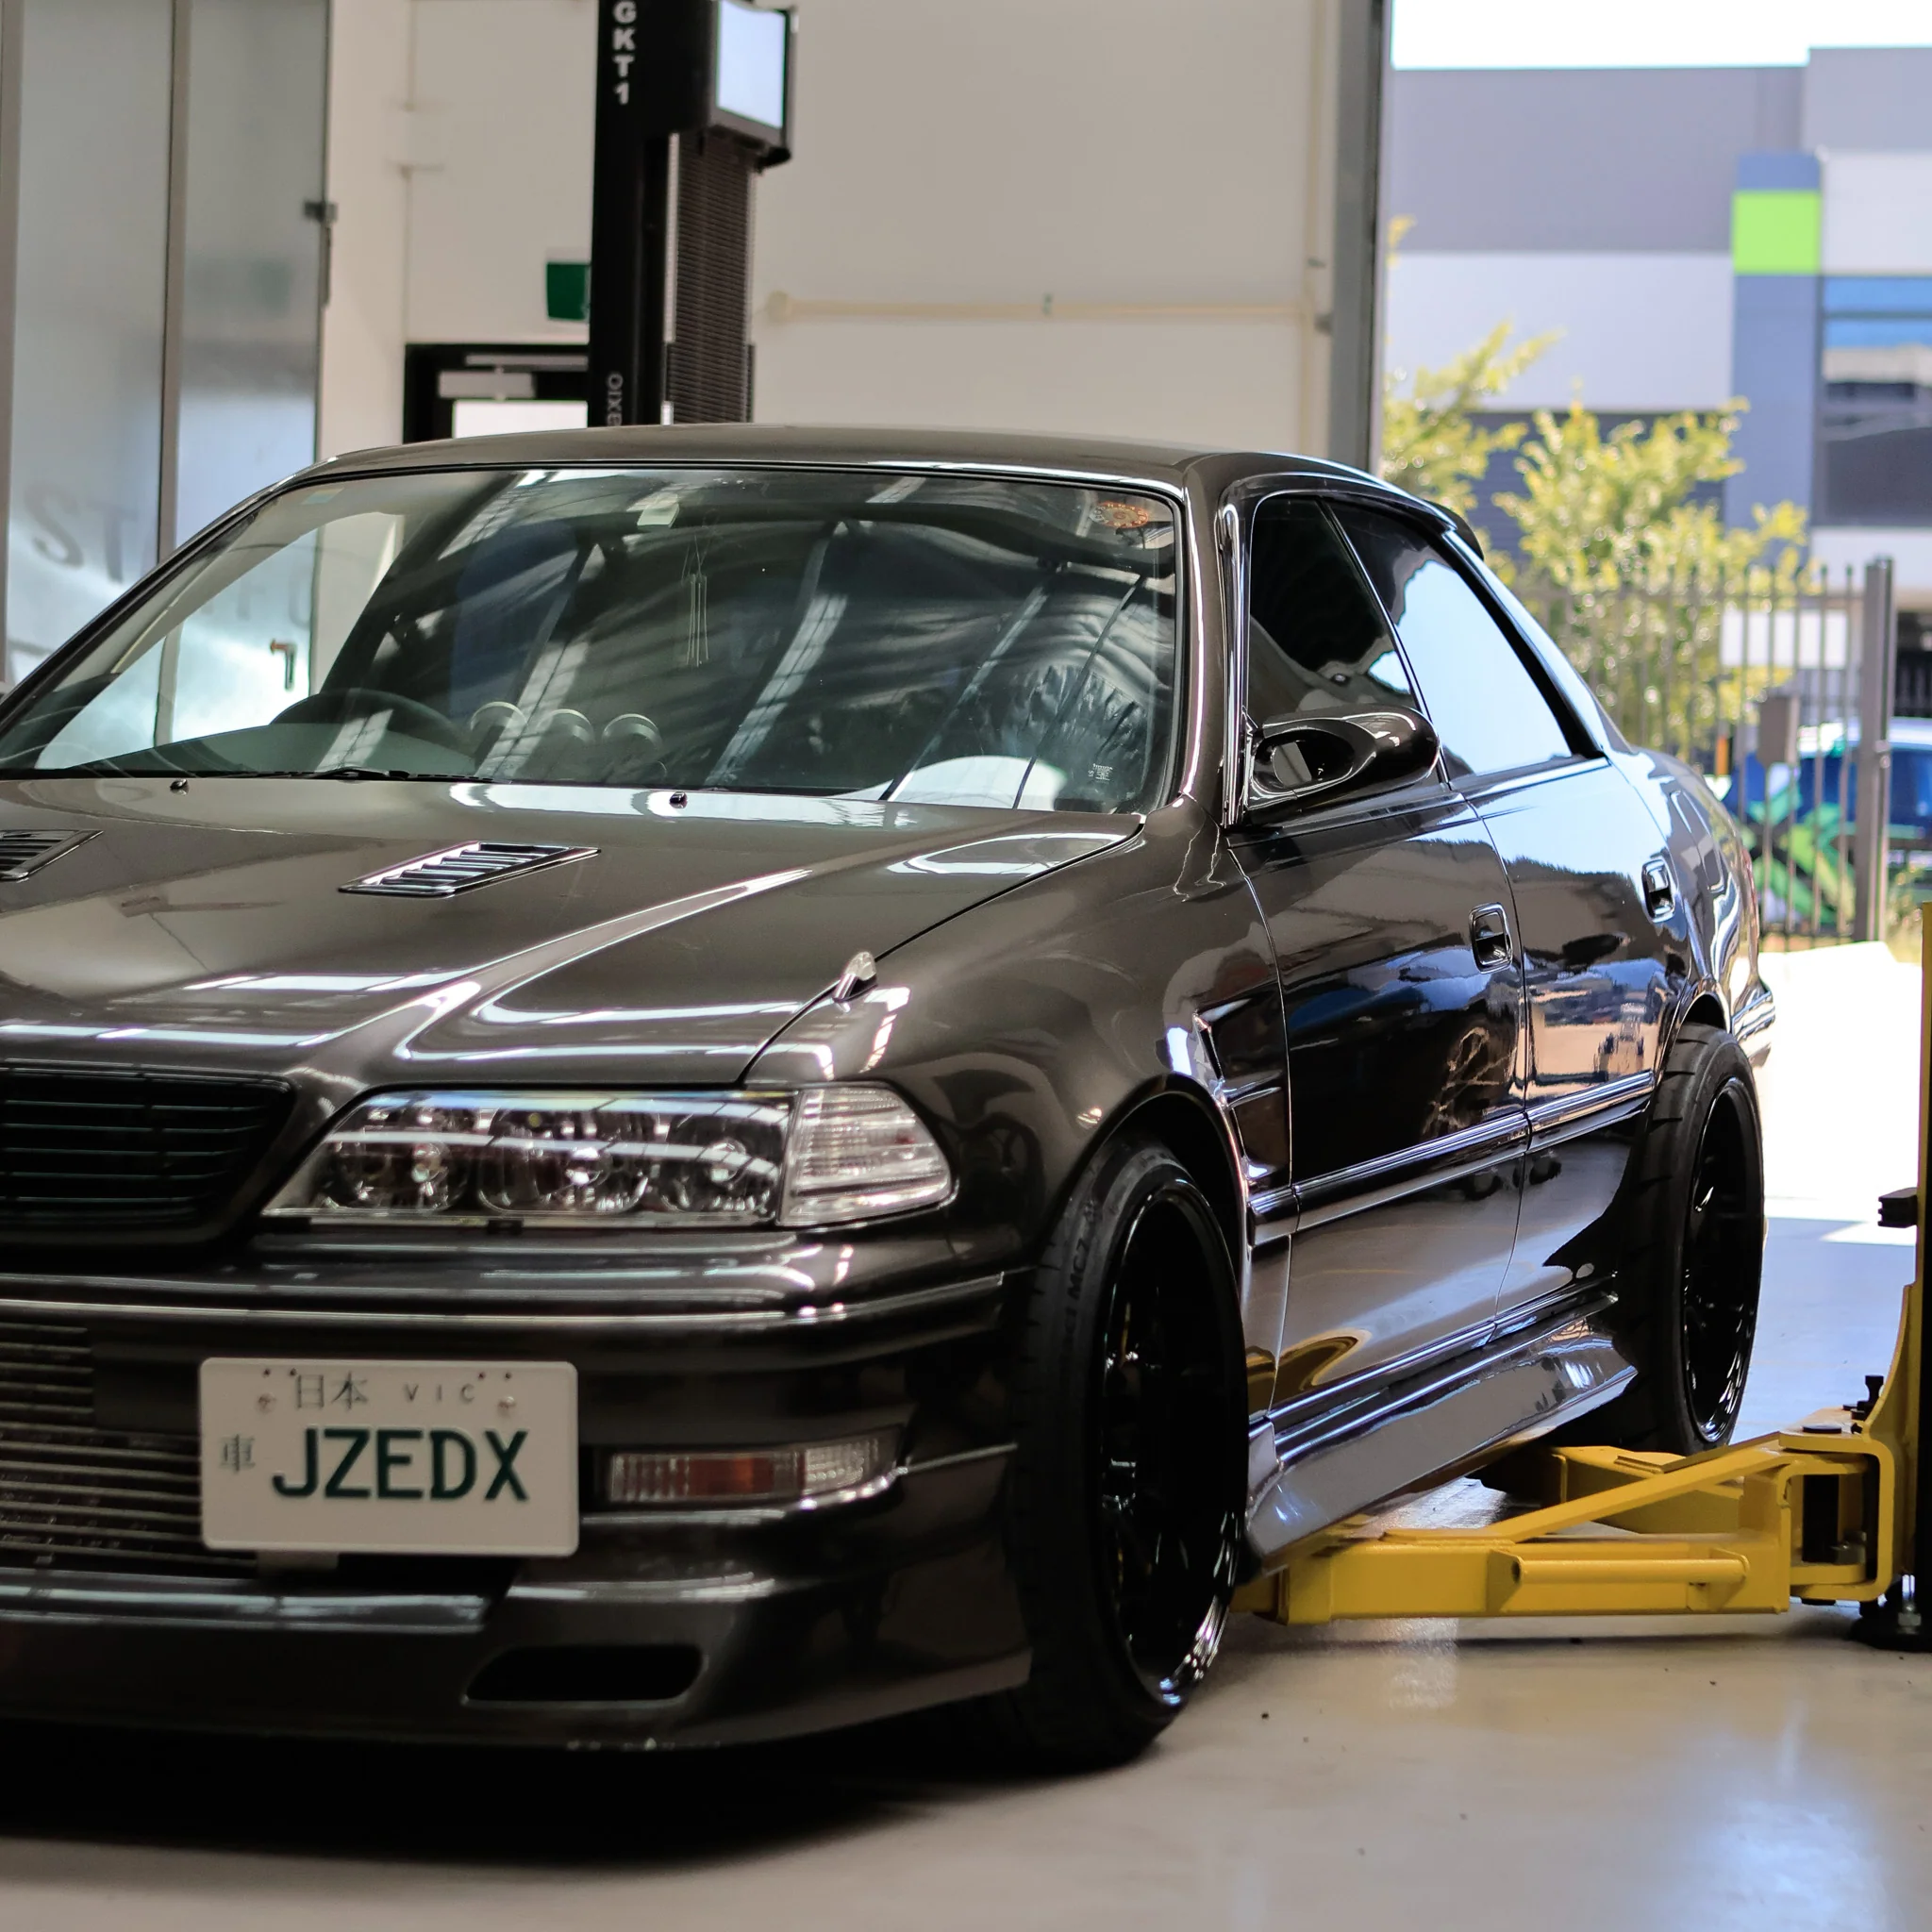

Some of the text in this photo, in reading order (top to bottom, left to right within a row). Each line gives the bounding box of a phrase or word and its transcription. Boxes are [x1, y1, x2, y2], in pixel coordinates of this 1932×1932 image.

[295, 1371, 477, 1411] 日本 VIC
[219, 1433, 257, 1474] 車
[271, 1426, 530, 1502] JZEDX
